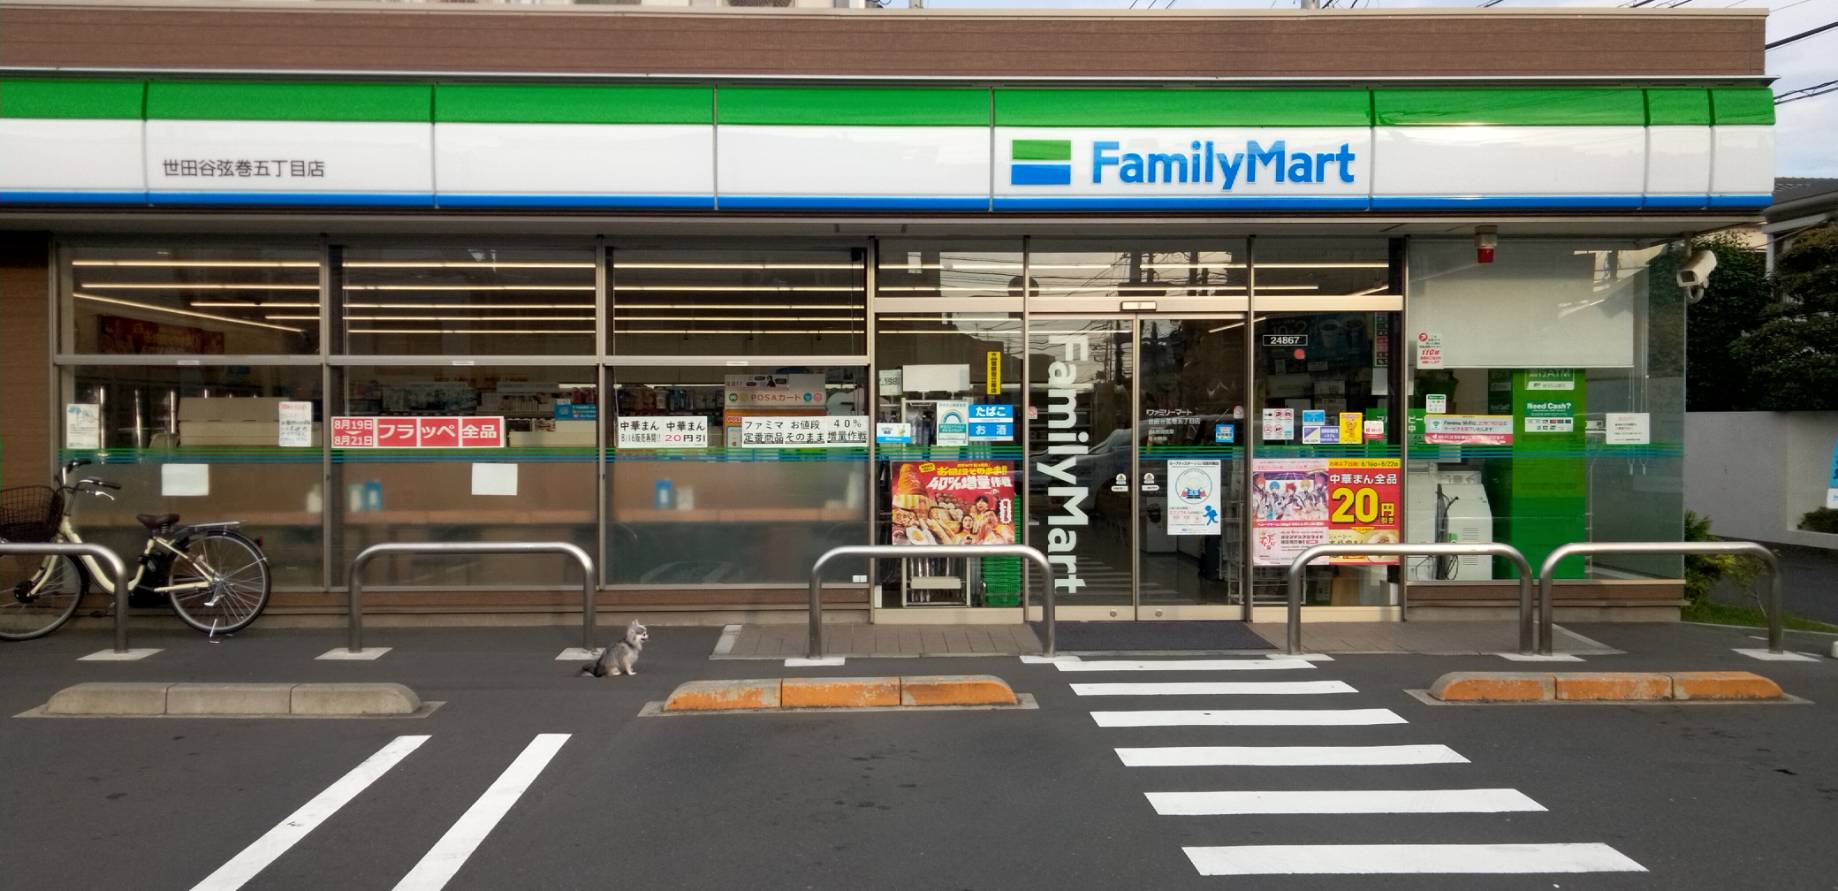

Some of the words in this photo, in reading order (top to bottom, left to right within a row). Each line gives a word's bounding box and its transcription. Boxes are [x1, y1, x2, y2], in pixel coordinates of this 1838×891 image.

[162, 159, 325, 177] 世田谷弦巻五丁目店
[1092, 140, 1355, 191] FamilyMart
[1270, 336, 1300, 345] 24867
[975, 406, 1007, 417] たばこ
[1547, 402, 1572, 410] Cash?
[334, 420, 373, 430] 8月19日
[620, 420, 660, 432] 中華まん
[666, 420, 706, 432] 中華まん
[744, 421, 784, 429] ファミマ
[791, 420, 820, 430] お値段
[378, 424, 497, 439] フラッペ全品
[744, 432, 784, 442] 定番商品
[785, 432, 825, 441] そのまま
[827, 431, 867, 441] 増量作戦
[334, 436, 373, 446] 8月21日
[1036, 335, 1089, 594] FamilyMart
[1330, 474, 1397, 485] 中華まん全品
[1331, 487, 1379, 523] 20
